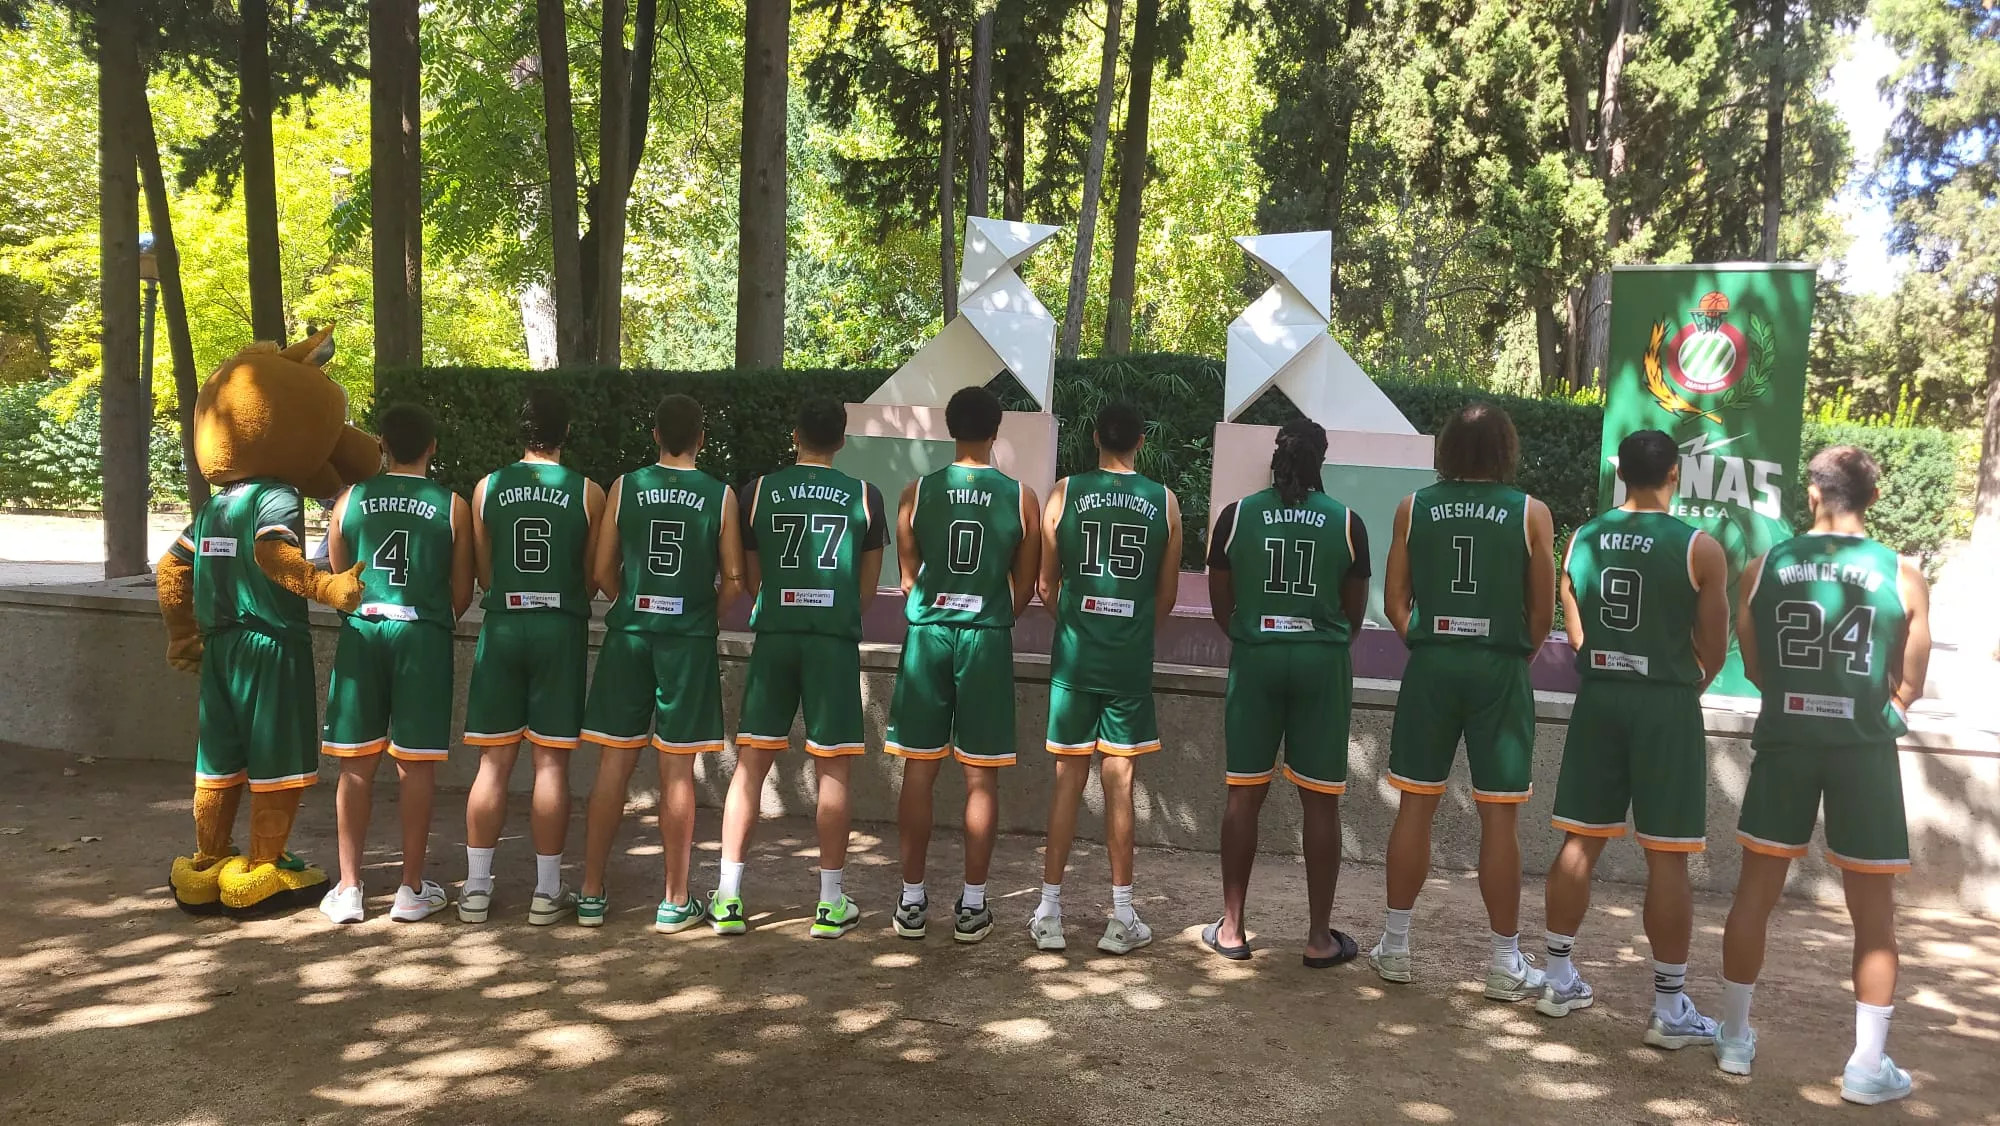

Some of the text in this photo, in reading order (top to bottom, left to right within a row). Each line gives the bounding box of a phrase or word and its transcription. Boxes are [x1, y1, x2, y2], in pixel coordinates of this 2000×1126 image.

[359, 497, 437, 520] TERREROS
[498, 486, 570, 509] CORRALIZA
[636, 488, 706, 511] FIGUEROA
[771, 483, 850, 506] G. VÁZQUEZ
[946, 489, 992, 507] THIAM
[1074, 492, 1158, 521] LÓPEZ-SANVICENTE
[1430, 503, 1508, 525] BIESHAAR
[1262, 508, 1327, 528] BADMUS
[373, 530, 409, 586] 4
[513, 517, 551, 573] 6
[648, 519, 685, 576] 5
[771, 513, 848, 570] 77
[948, 519, 984, 575] 0
[1079, 520, 1148, 580] 15
[1600, 533, 1654, 554] KREPS
[1264, 537, 1316, 597] 11
[1451, 535, 1477, 594] 1
[1778, 559, 1818, 587] RUBÍN
[1821, 562, 1840, 582] DE
[1600, 567, 1642, 632] 9
[1775, 600, 1876, 676] 24
